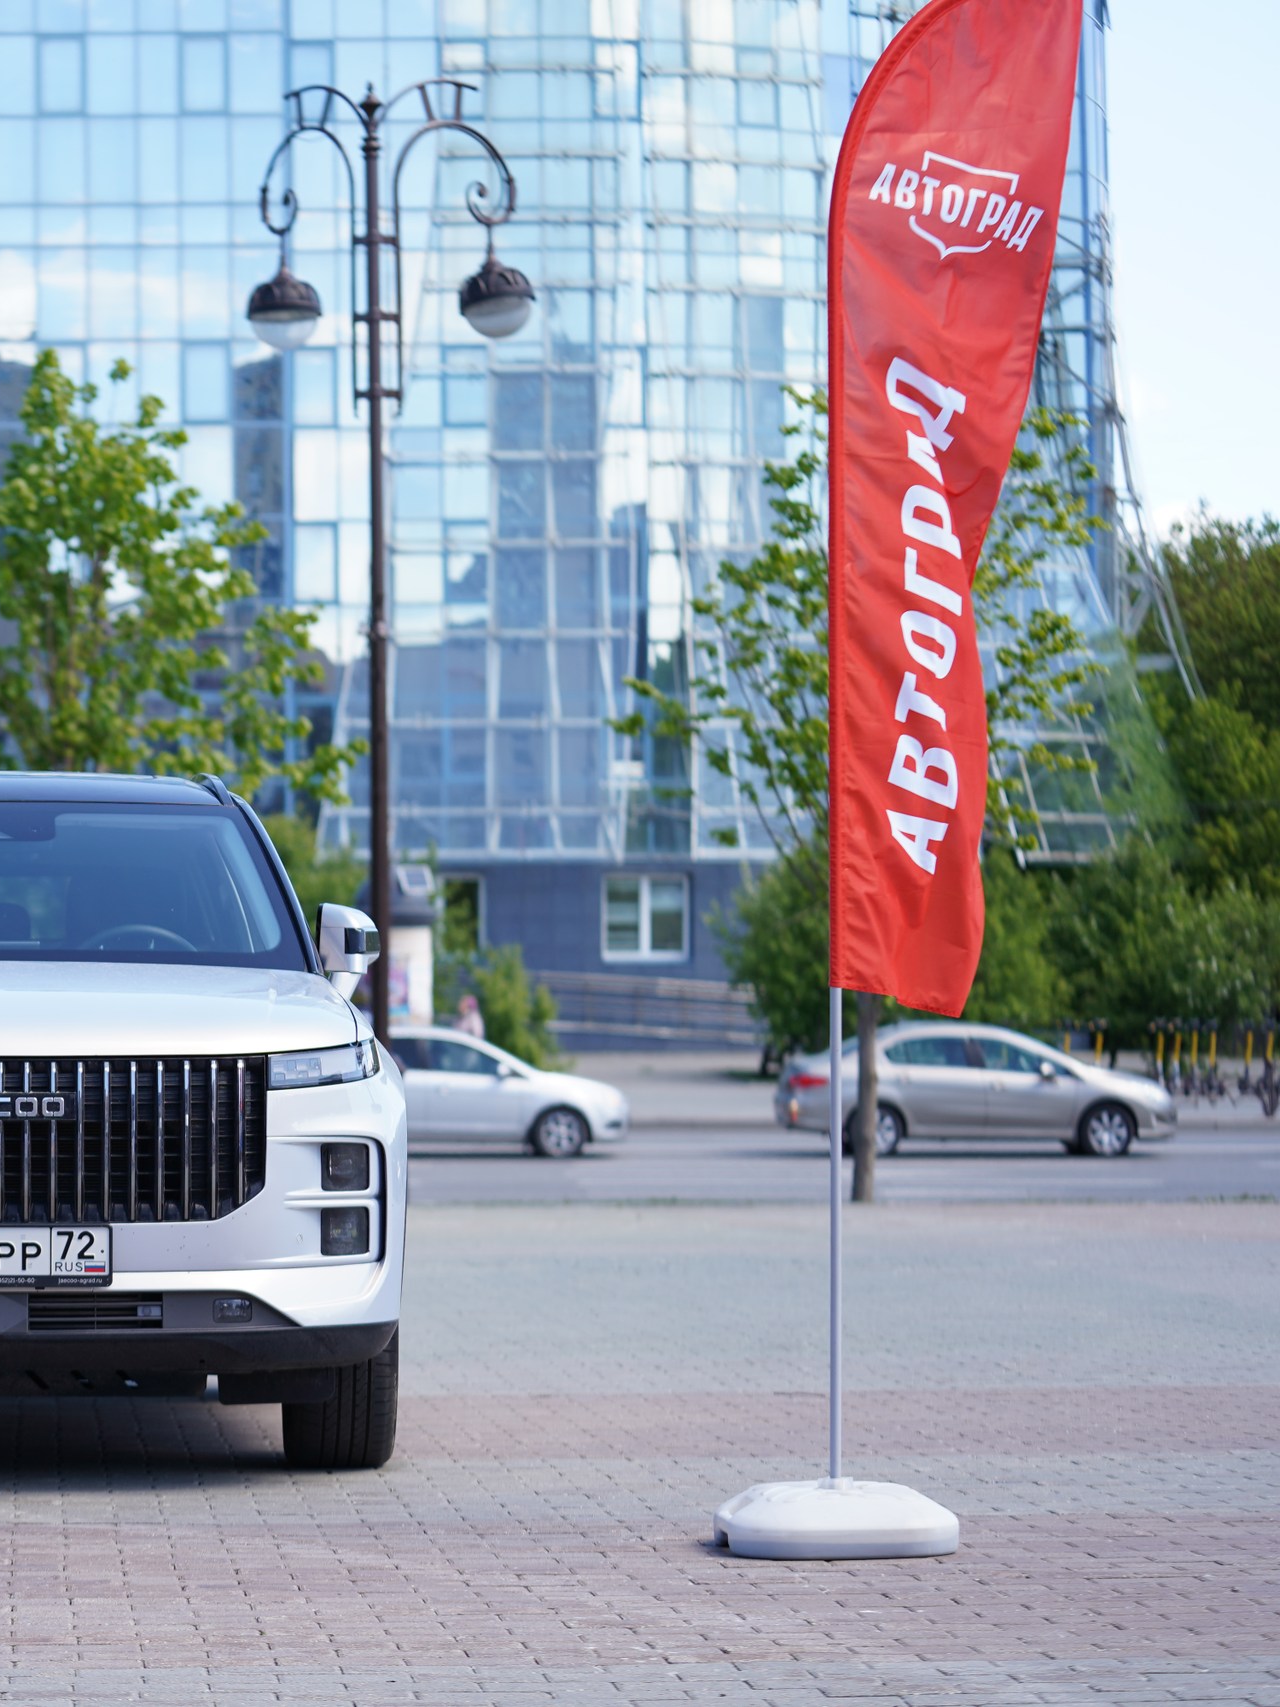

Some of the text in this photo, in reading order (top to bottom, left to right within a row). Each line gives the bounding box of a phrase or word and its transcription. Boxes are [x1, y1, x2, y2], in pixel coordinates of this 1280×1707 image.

[868, 162, 1045, 253] АВТОГРАД
[57, 1231, 95, 1260] 72
[55, 1262, 83, 1272] RUS
